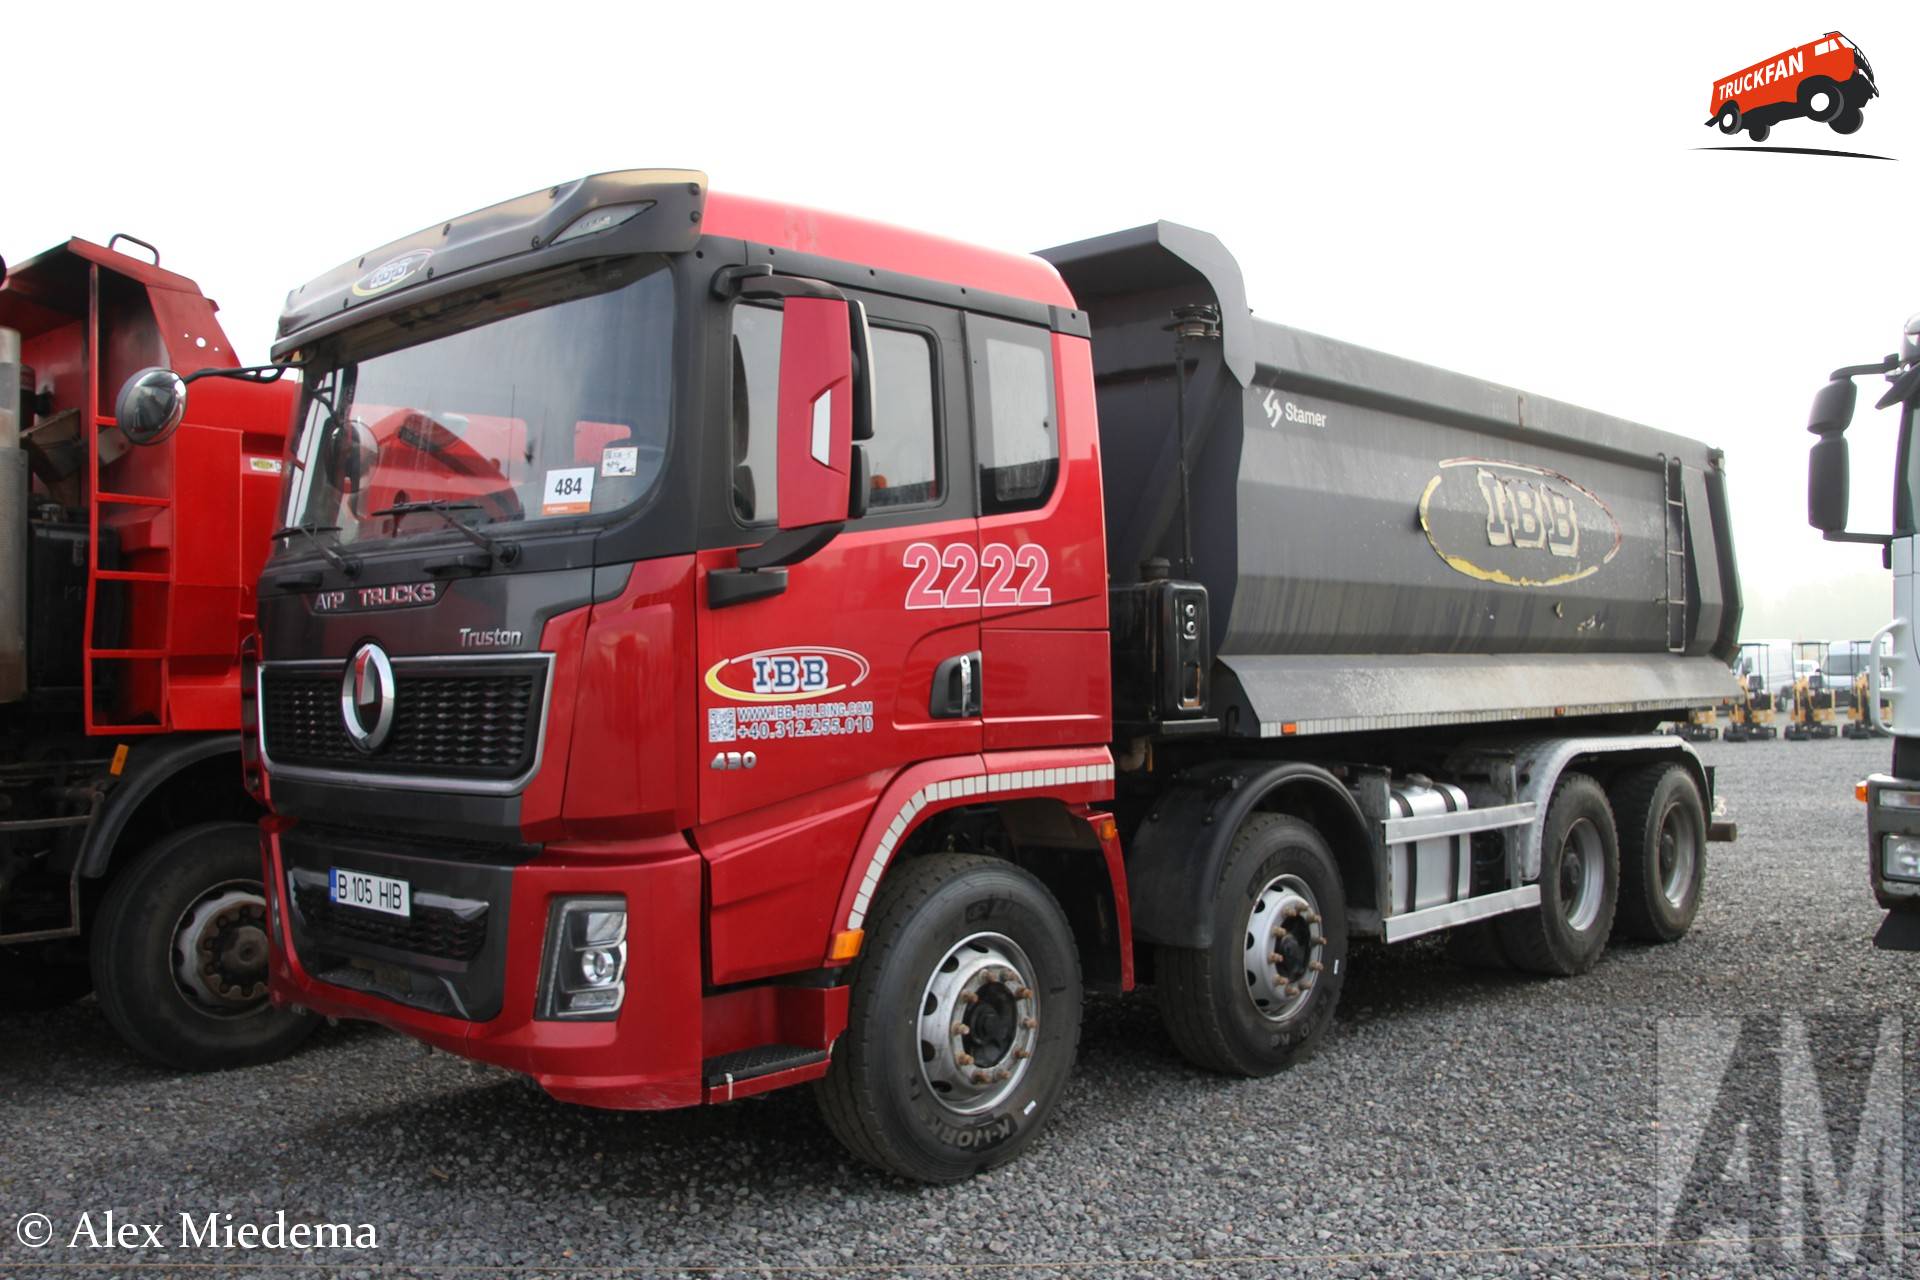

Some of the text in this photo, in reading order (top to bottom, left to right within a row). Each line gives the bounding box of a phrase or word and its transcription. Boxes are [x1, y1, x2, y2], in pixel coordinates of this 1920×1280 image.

[1285, 401, 1327, 428] Stamer
[555, 477, 582, 496] 484
[1477, 466, 1580, 558] IBB
[902, 542, 1052, 610] 2222
[314, 582, 436, 610] ATP TRUCKS
[459, 627, 524, 648] Truston
[752, 655, 829, 693] IBB
[736, 716, 874, 741] +40.312.255.010
[338, 873, 402, 910] B 105 HIB
